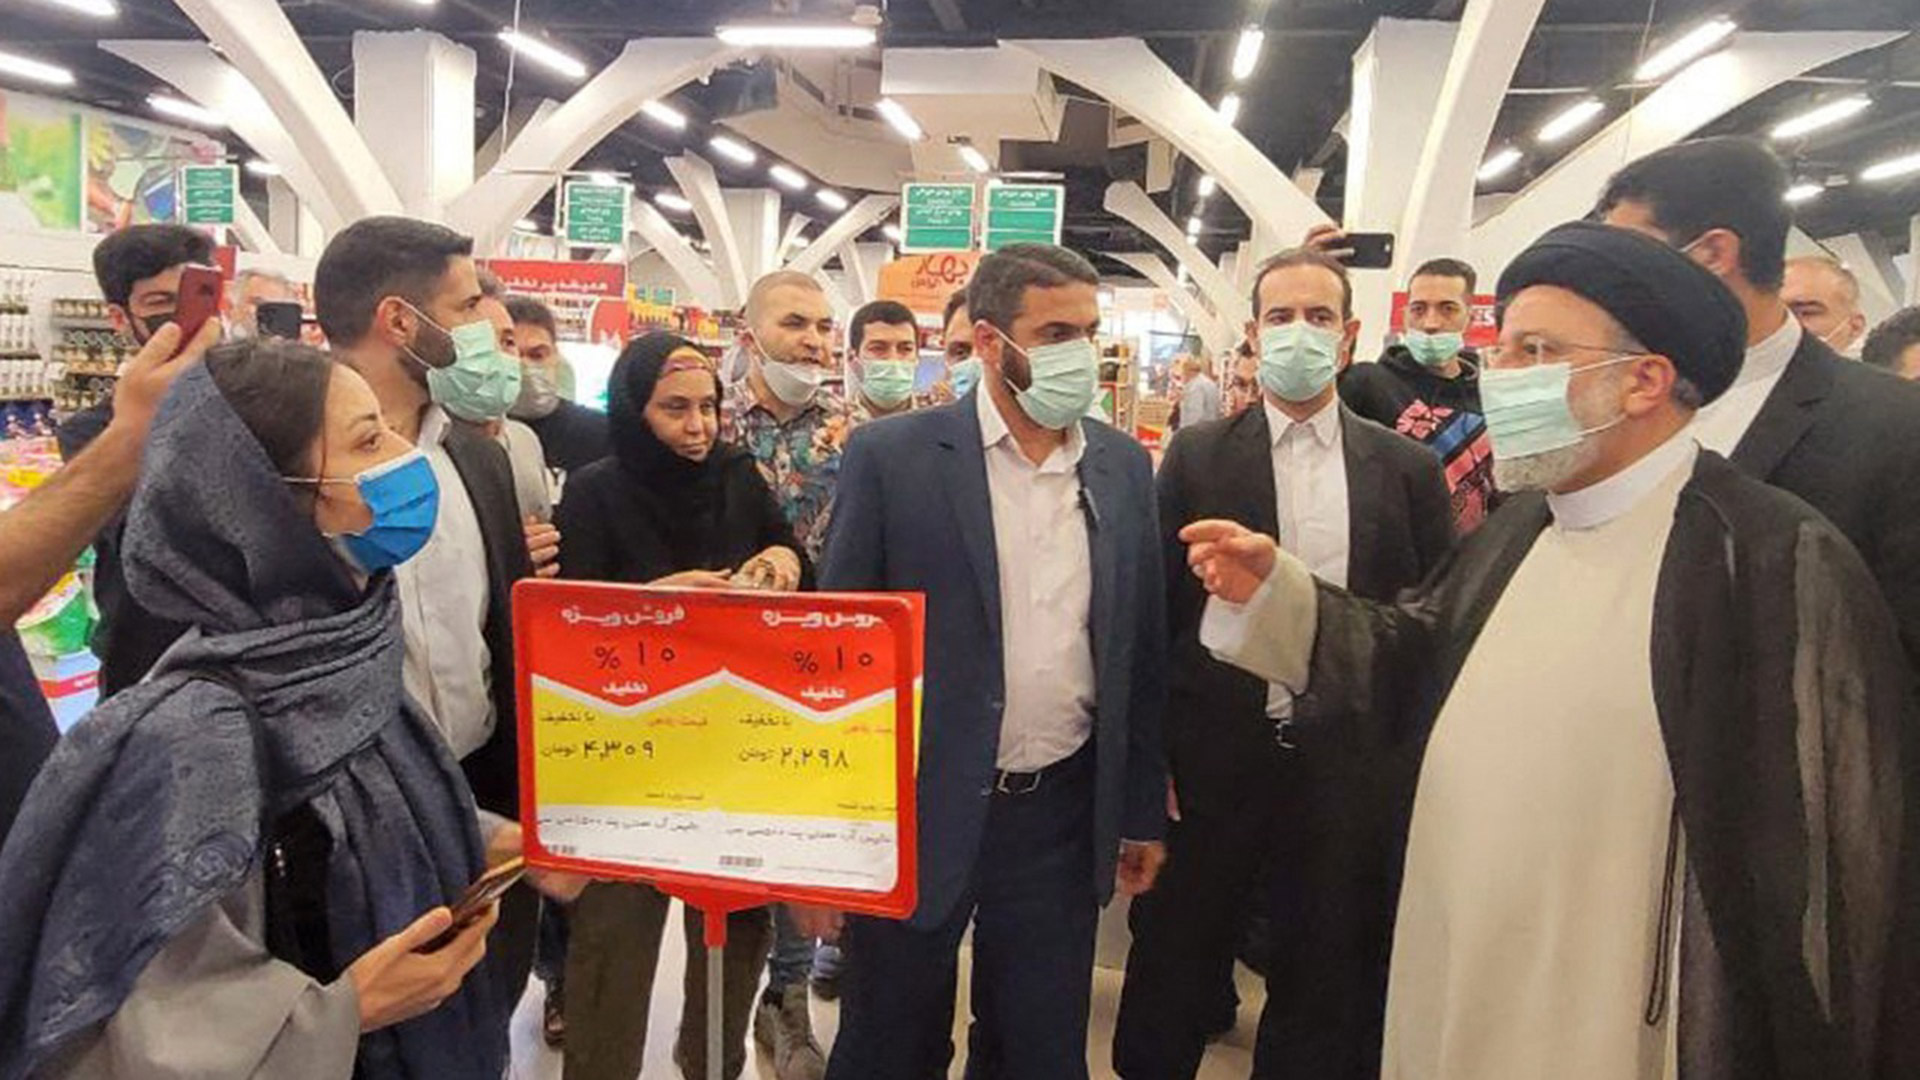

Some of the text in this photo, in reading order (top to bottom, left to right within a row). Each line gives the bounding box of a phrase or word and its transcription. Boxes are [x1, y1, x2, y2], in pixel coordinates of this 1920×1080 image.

[561, 604, 686, 626] فروش ویژه
[602, 680, 649, 697] تخفیف
[801, 684, 847, 703] تخفیف
